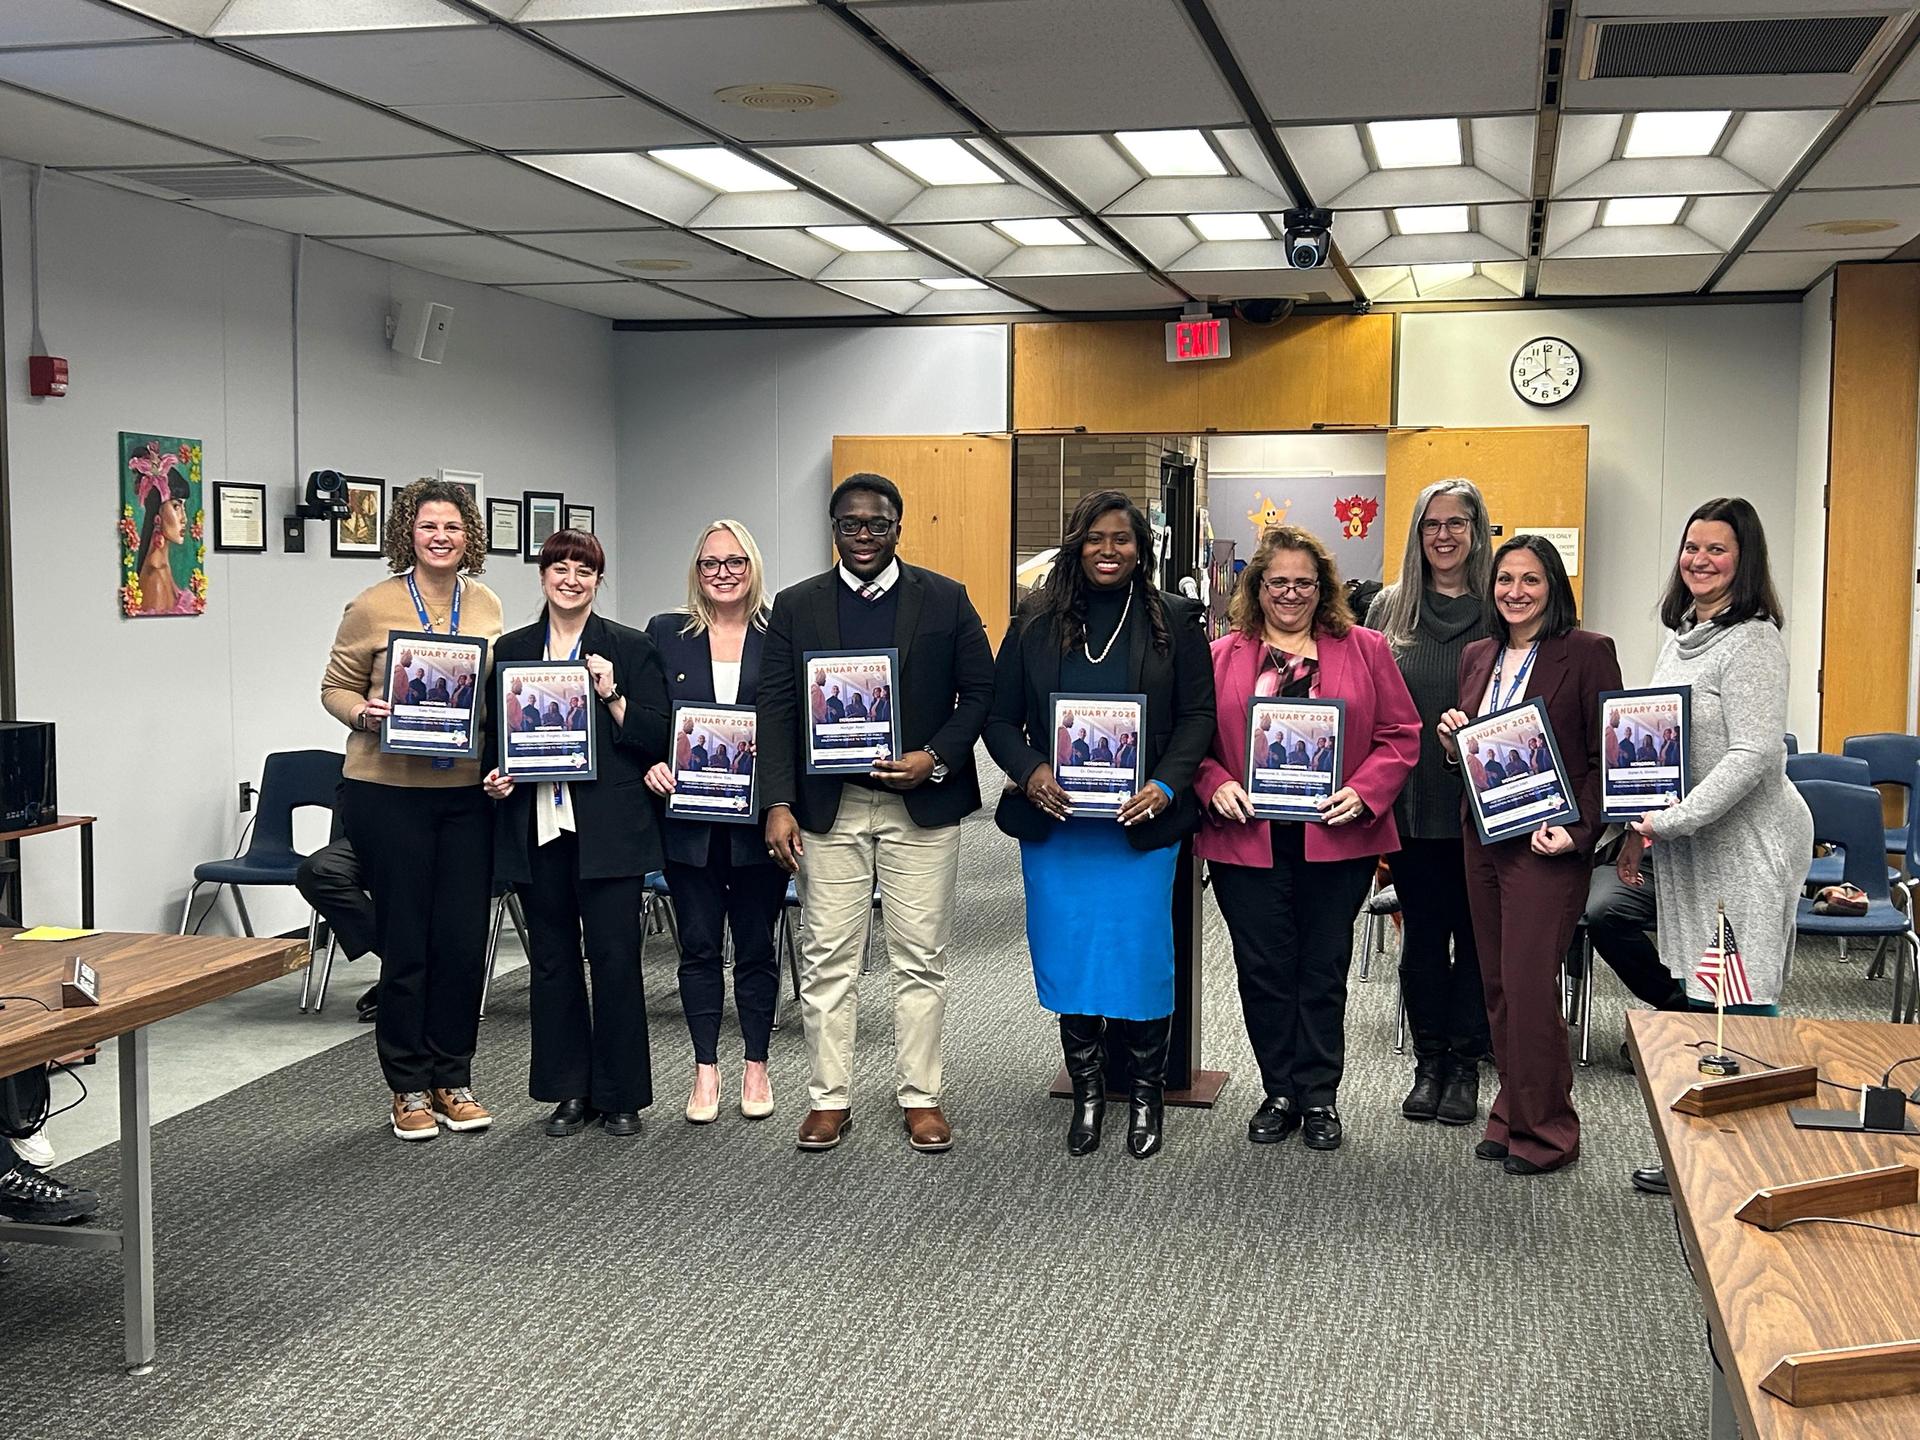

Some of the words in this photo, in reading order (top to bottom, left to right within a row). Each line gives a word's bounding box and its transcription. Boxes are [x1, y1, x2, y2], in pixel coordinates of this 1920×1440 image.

[1176, 320, 1220, 358] EXIT
[1532, 348, 1540, 356] 11
[1543, 344, 1553, 353] 12
[1558, 348, 1562, 356] 1
[1518, 368, 1526, 376] 9
[1566, 367, 1574, 376] 3
[1522, 379, 1530, 388] 8
[1562, 379, 1570, 387] 4
[1531, 387, 1538, 395] 7
[1541, 390, 1549, 398] 6
[1553, 387, 1561, 395] 5
[400, 648, 448, 658] JANUARY
[451, 652, 477, 660] 2026
[814, 666, 859, 674] JANUARY
[510, 675, 556, 683] JANUARY
[1610, 706, 1651, 715] JANUARY
[1655, 704, 1678, 712] 2026
[1112, 710, 1136, 718] 2026
[1259, 712, 1305, 720] JANUARY
[1310, 714, 1334, 722] 2026
[683, 716, 727, 725] JANUARY
[731, 719, 754, 727] 2026
[1466, 724, 1508, 744] JANUARY
[1512, 713, 1537, 727] 2026
